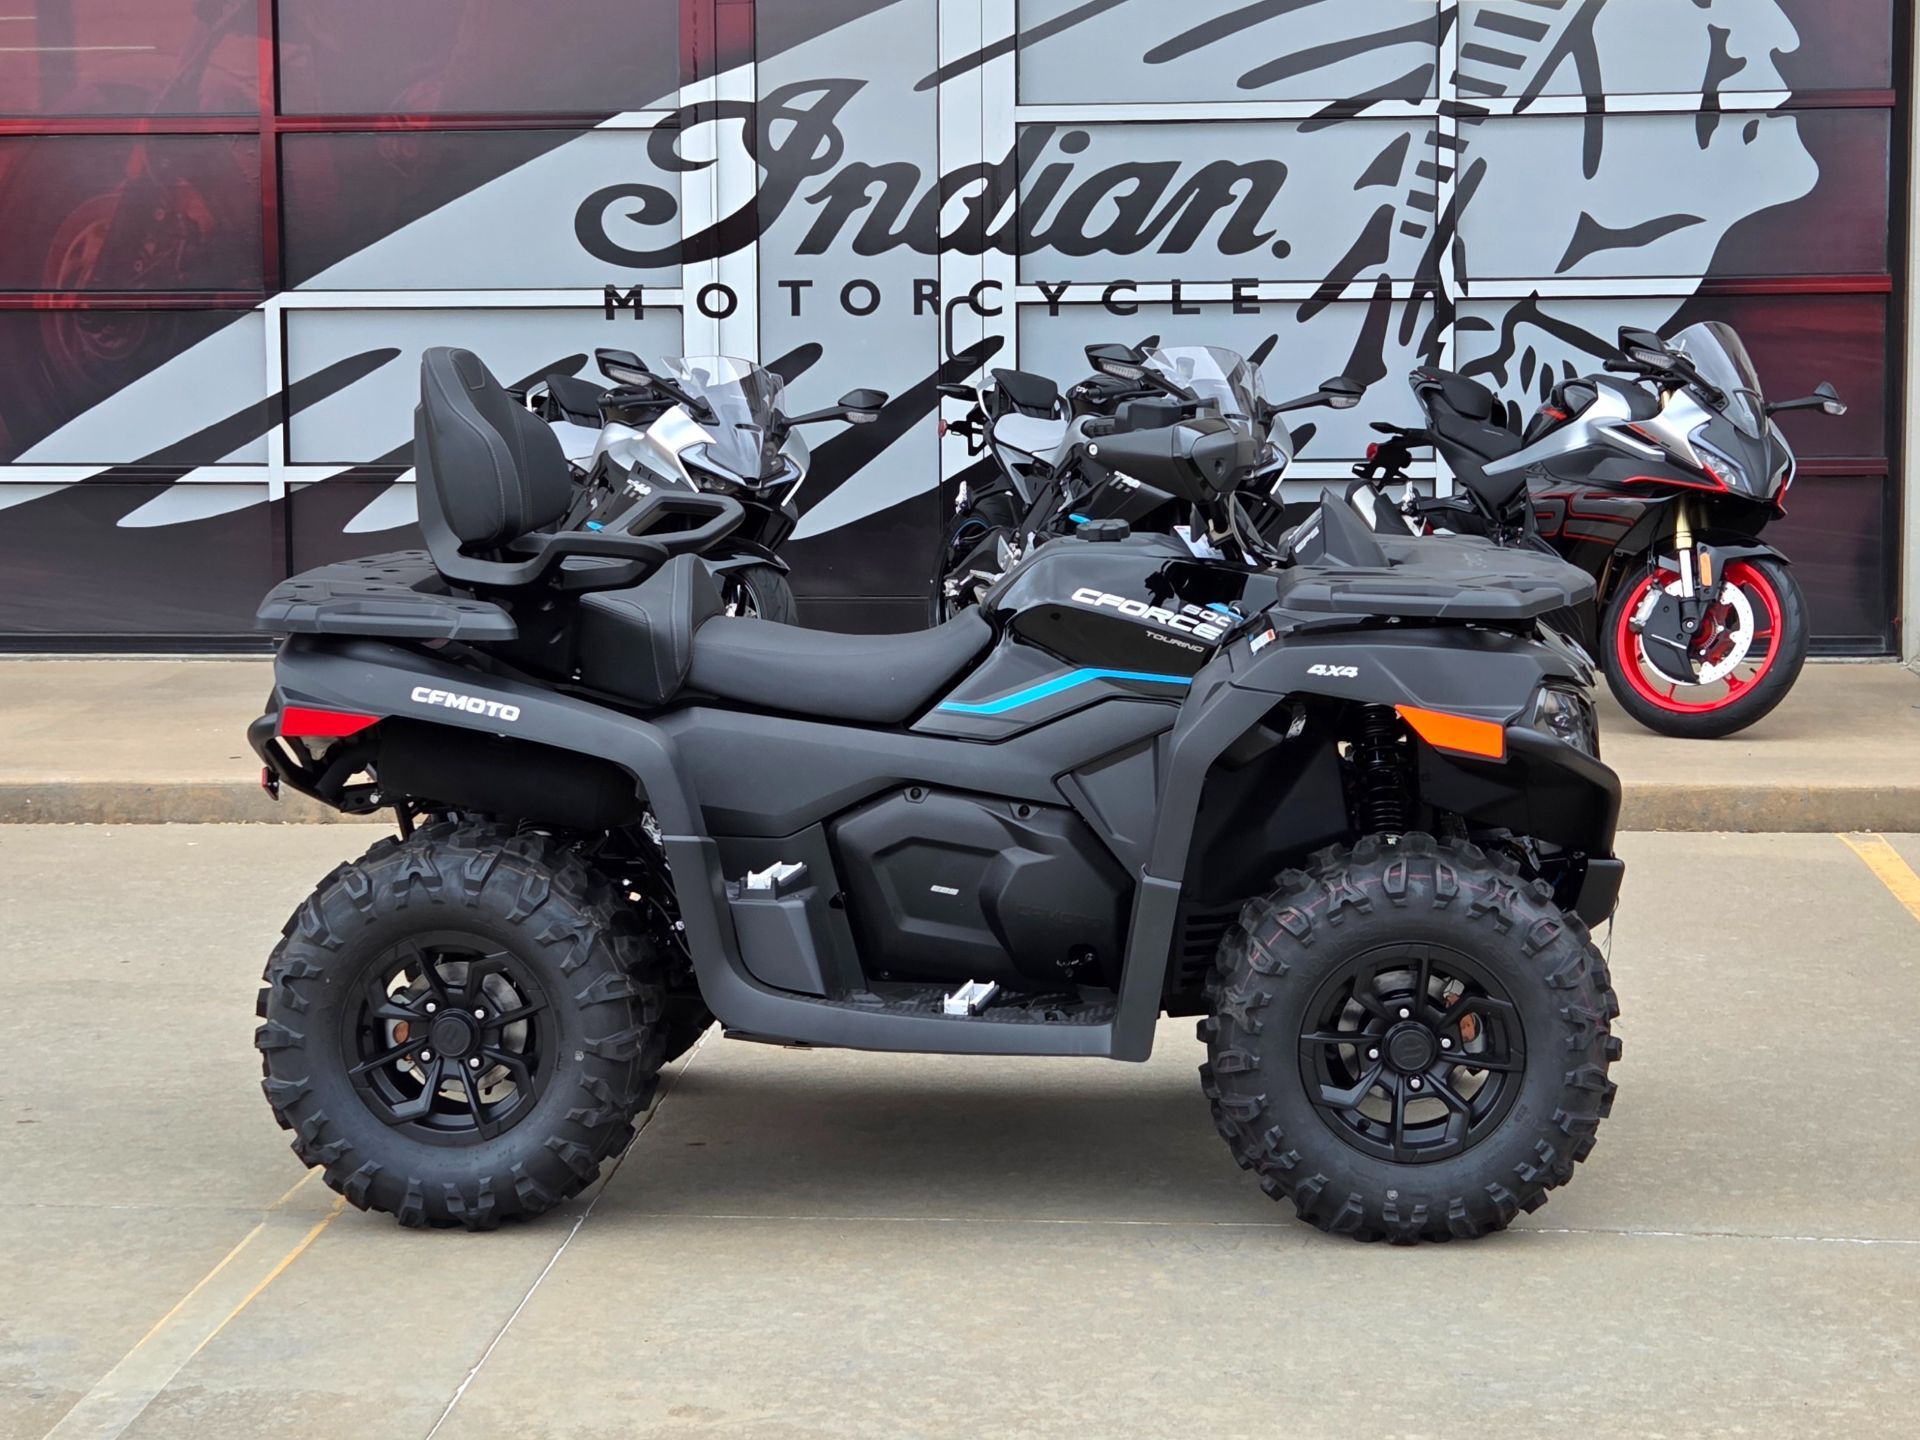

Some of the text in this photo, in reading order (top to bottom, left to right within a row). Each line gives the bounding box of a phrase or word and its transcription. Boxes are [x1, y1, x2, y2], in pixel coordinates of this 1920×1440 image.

[604, 277, 1261, 320] MOTORCYCLE
[1071, 588, 1224, 640] CFORCE
[1146, 630, 1204, 652] TOURING
[411, 687, 520, 721] CFMOTO
